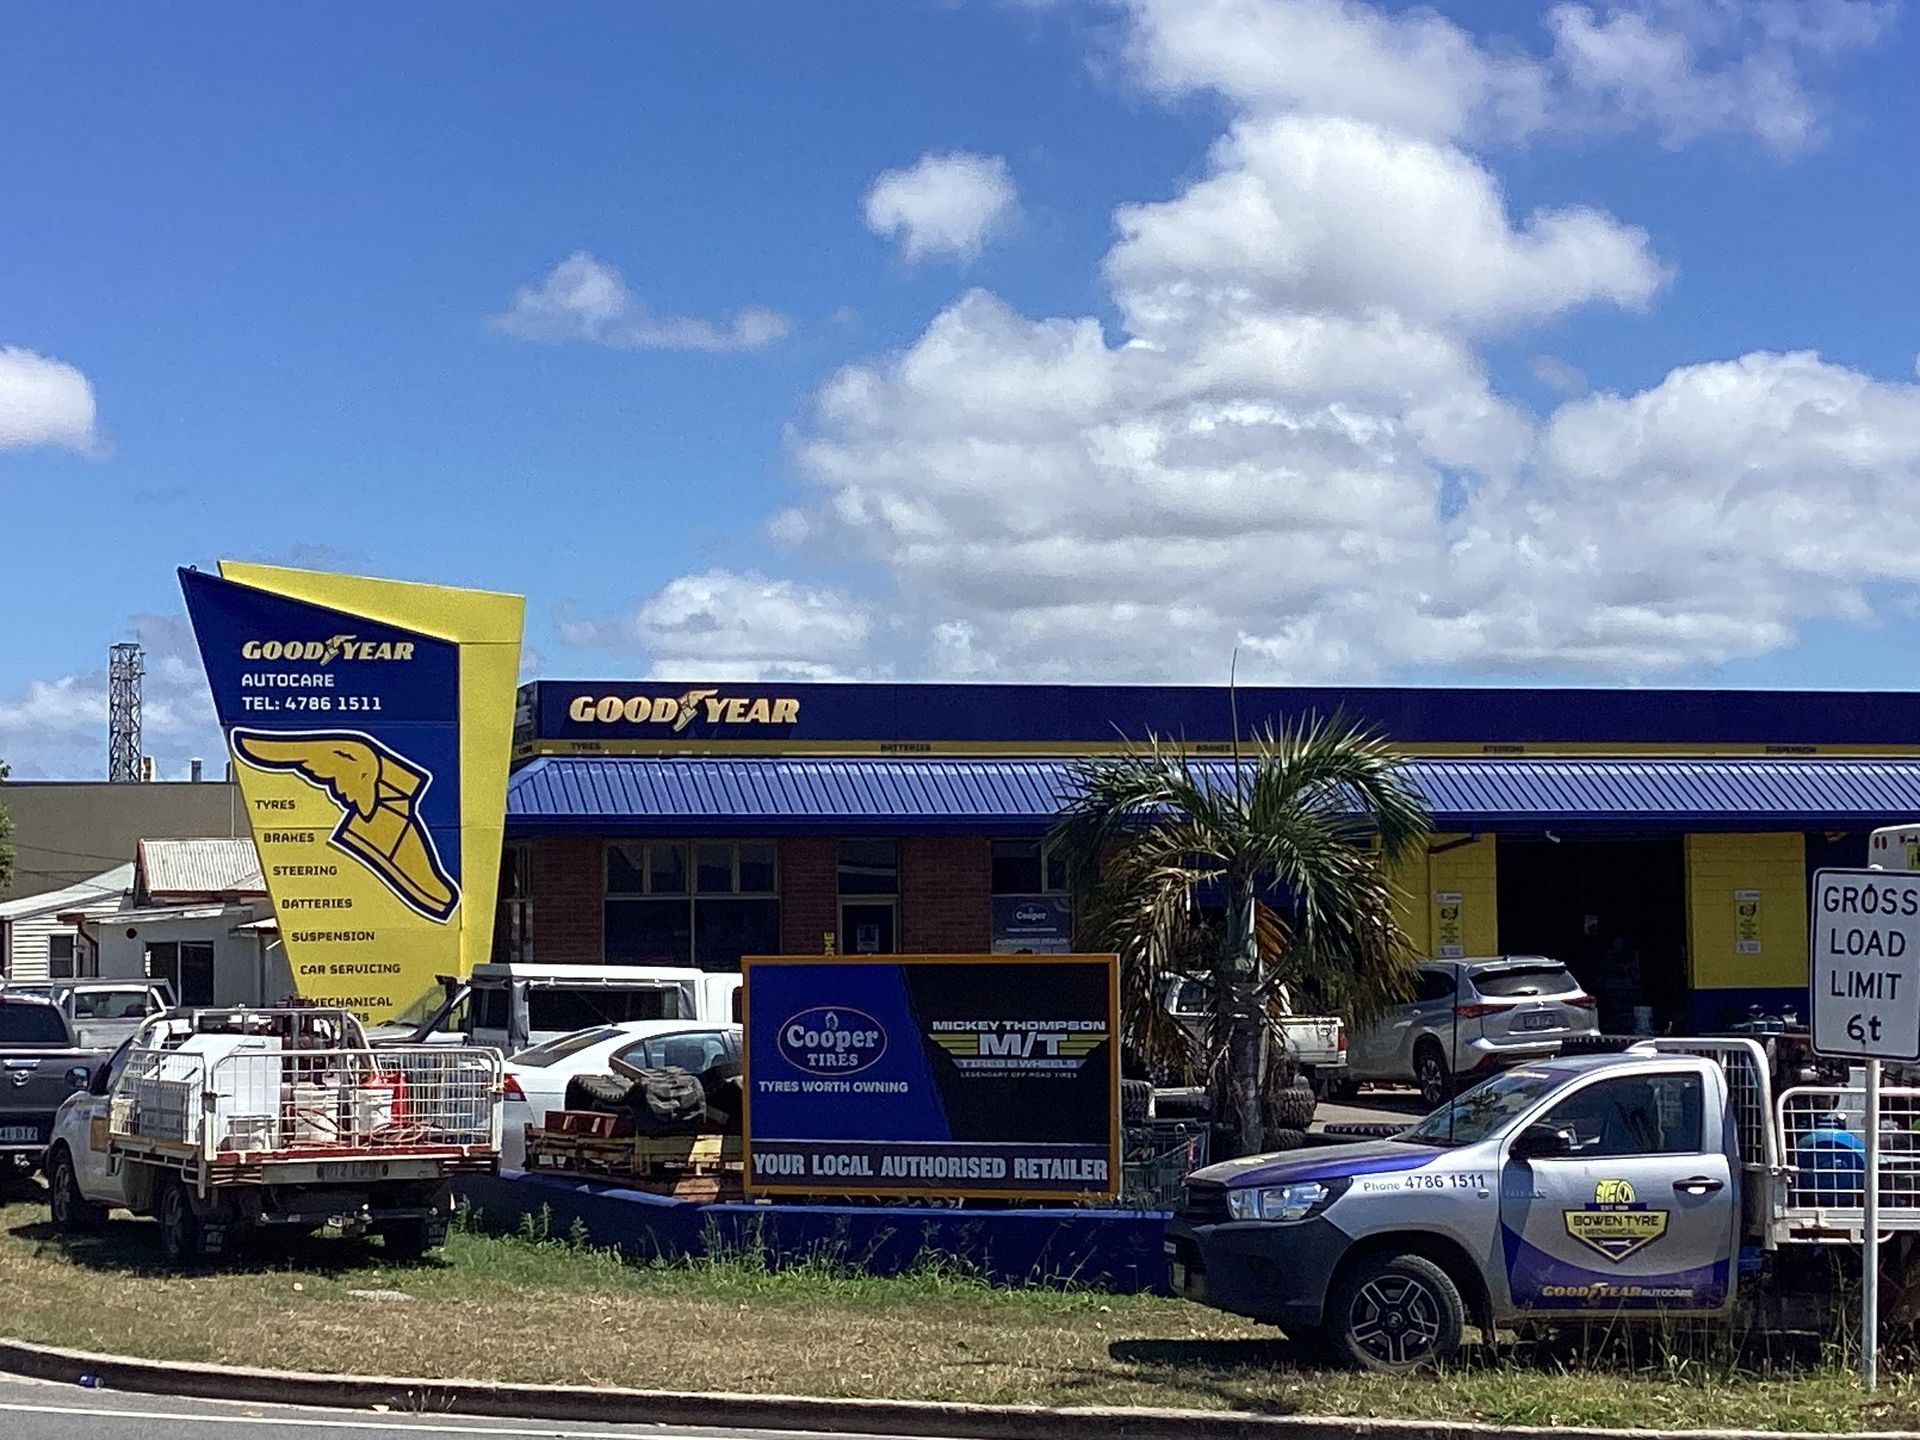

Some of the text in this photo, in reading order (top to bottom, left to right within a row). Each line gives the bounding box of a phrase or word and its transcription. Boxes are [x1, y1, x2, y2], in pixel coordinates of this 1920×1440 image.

[241, 674, 335, 688] AUTOCARE
[242, 696, 382, 711] TEL: 4786 1511
[255, 799, 296, 810] TYRES
[263, 832, 315, 843] BRAKES
[272, 865, 337, 876] STEERING
[281, 898, 353, 909] BATTERIES
[1823, 884, 1919, 916] GROSS
[291, 931, 375, 942] SUSPENSION
[1830, 928, 1906, 957] LOAD
[300, 963, 401, 975] CAR SERVICING
[1831, 969, 1902, 1000] LIMIT
[932, 1020, 1106, 1031] MICKEY THOMPSON
[1847, 1013, 1882, 1042] 6t
[786, 1025, 878, 1053] Cooper
[979, 1030, 1069, 1058] M/T
[807, 1053, 859, 1067] TIRES
[758, 1080, 909, 1094] TYRES WORTH OWNING
[753, 1153, 1109, 1181] YOUR LOCAL AUTHORISED RETAILER
[1363, 1173, 1485, 1192] Phone 4786 1511
[1573, 1215, 1660, 1227] BOWEN TYRE
[1642, 1288, 1694, 1298] AUTOCARE
